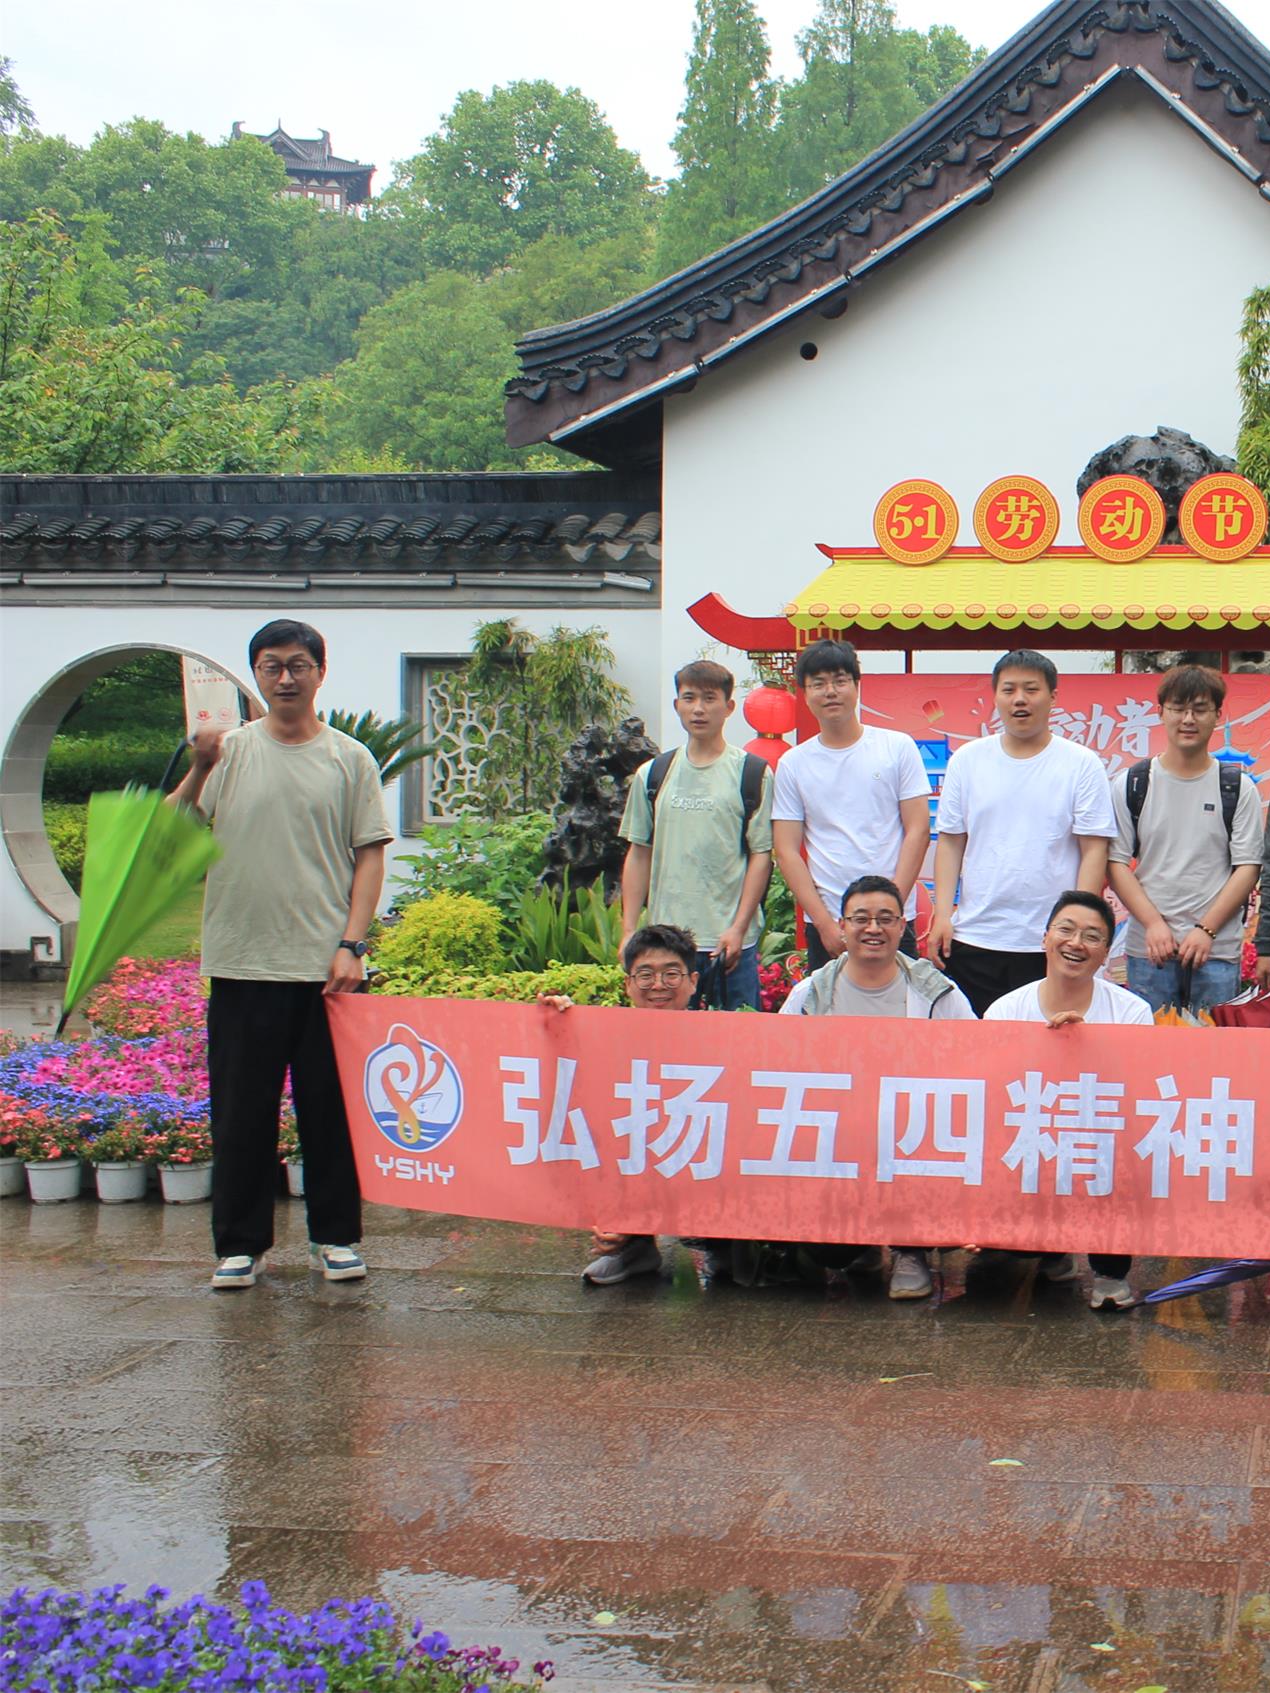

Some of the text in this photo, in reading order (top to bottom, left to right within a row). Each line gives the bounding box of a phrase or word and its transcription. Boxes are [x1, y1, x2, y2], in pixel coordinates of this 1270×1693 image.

[374, 1154, 456, 1185] YSHY
[500, 1055, 1256, 1202] 弘扬五四精神
